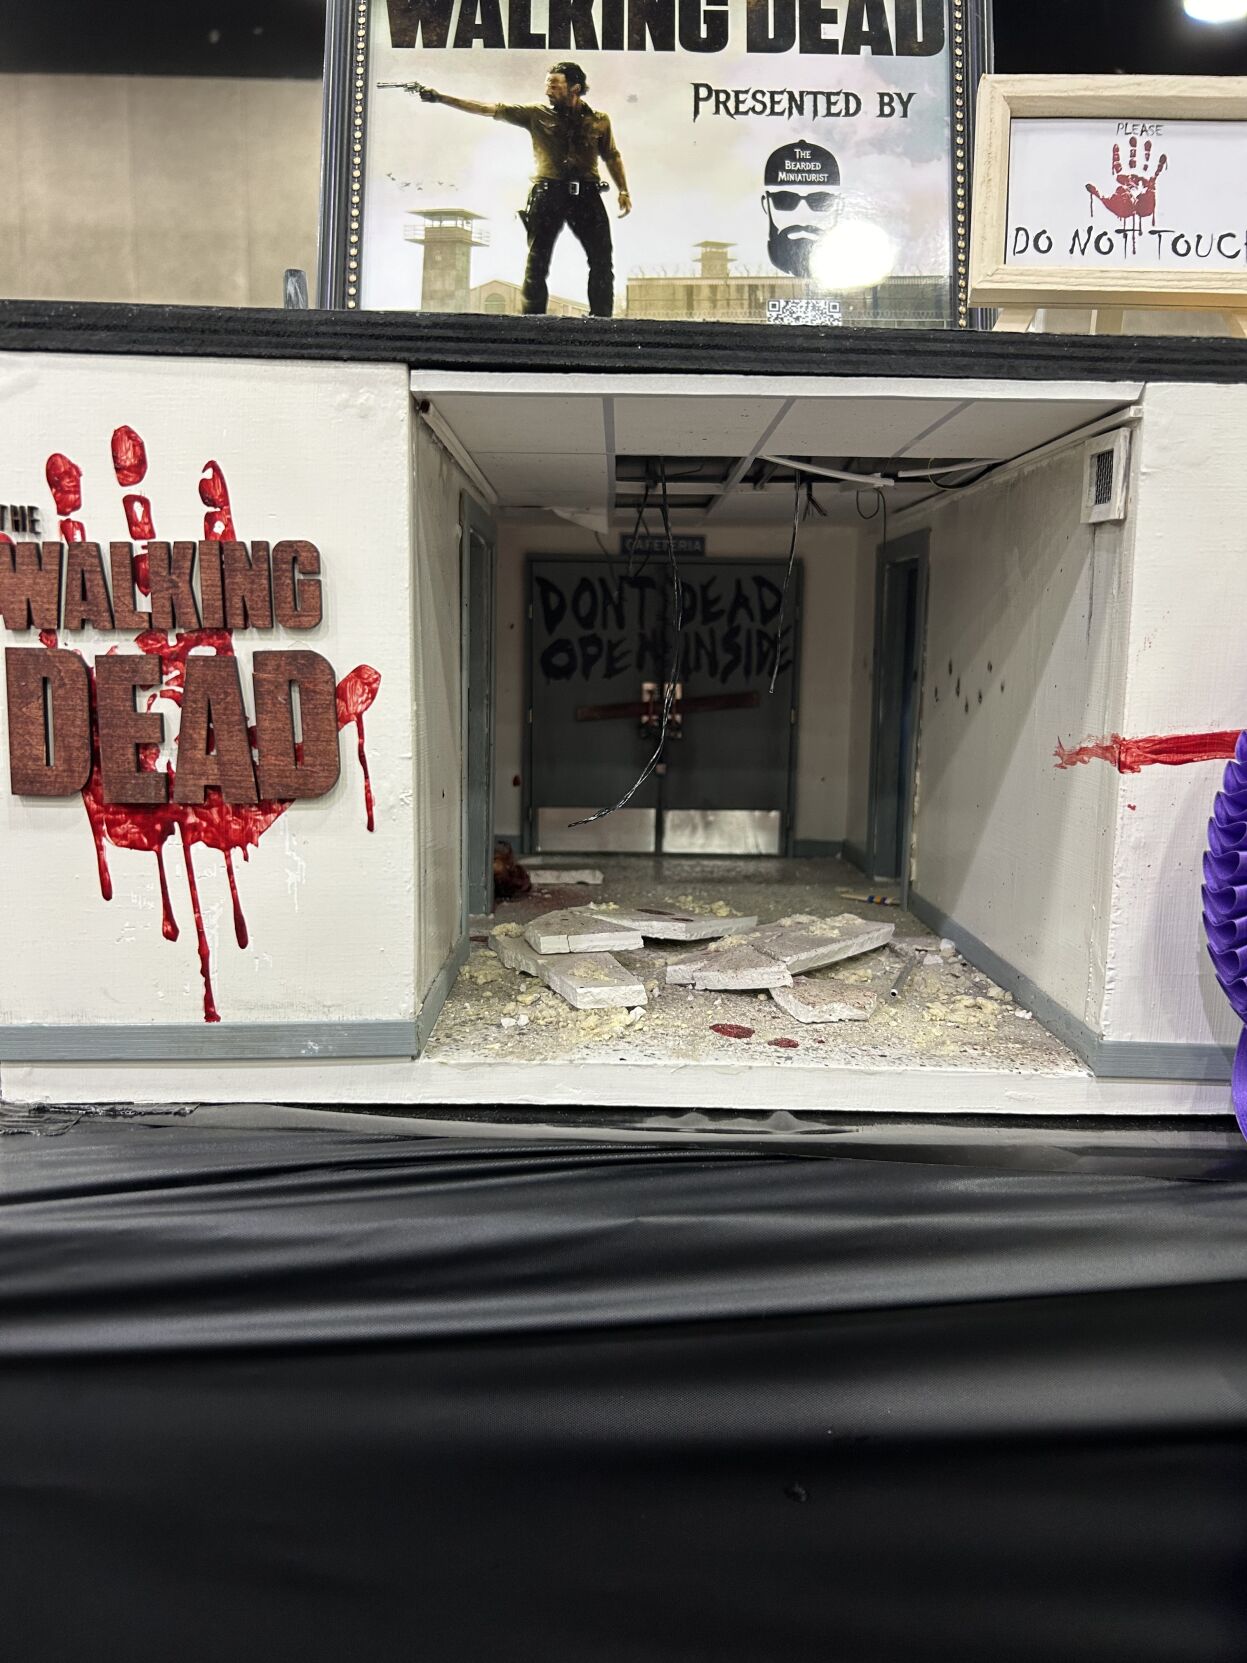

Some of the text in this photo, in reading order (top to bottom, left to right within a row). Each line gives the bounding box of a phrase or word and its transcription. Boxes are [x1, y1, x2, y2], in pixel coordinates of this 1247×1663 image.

[386, 0, 946, 57] WALKING DEAD
[690, 83, 917, 122] PRESENTED BY
[1116, 122, 1164, 137] PLEASE
[784, 160, 822, 171] BEARDED
[794, 149, 812, 159] THE
[777, 171, 829, 183] MINIATURIST
[1013, 225, 1247, 264] DO NOT TOUC
[0, 539, 323, 631] WALKING
[677, 574, 783, 629] DEAD
[540, 625, 793, 685] OPEN INSIDE
[5, 646, 342, 805] DEAD
